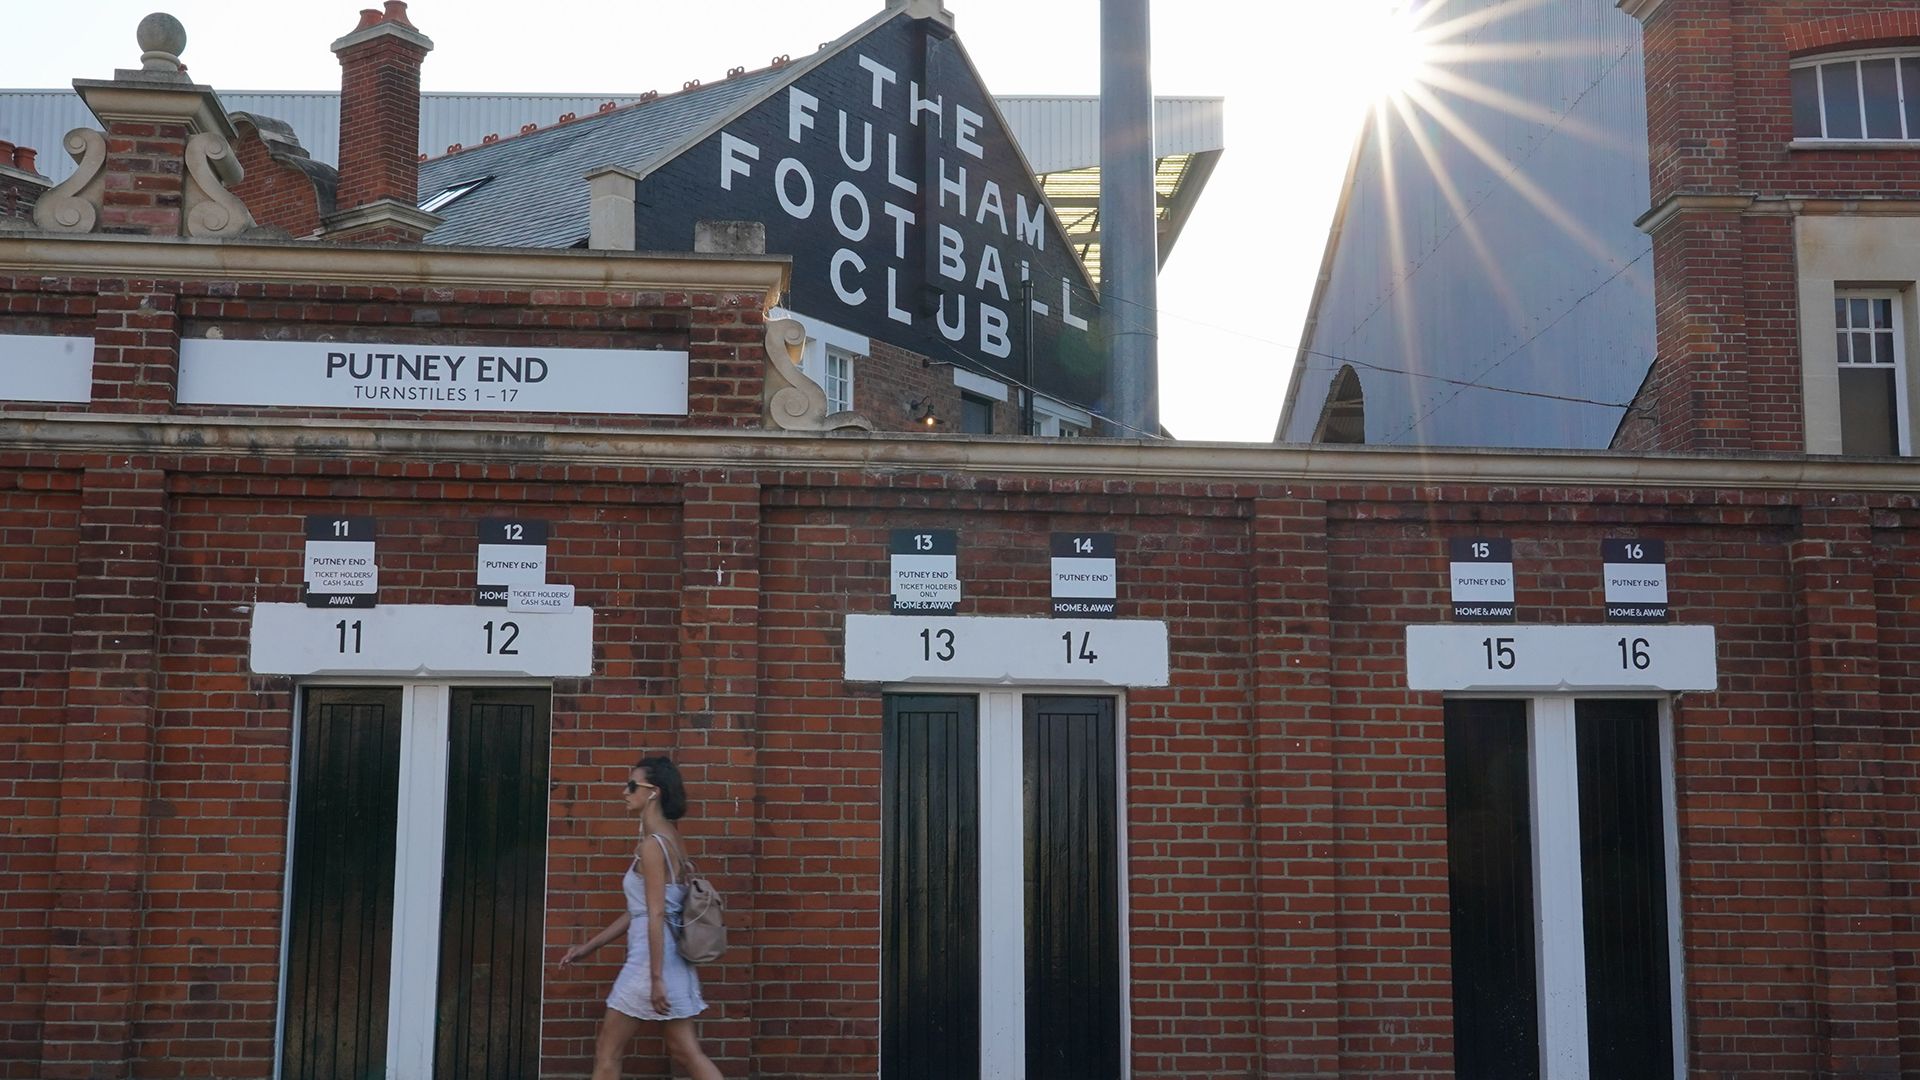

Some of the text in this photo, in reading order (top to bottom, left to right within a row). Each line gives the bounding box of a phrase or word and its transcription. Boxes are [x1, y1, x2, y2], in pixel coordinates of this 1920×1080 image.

[859, 54, 984, 160] THE
[789, 85, 1045, 252] FULHAM
[829, 248, 1012, 359] CLUB
[326, 352, 548, 383] PUTNEY END
[354, 385, 467, 401] TURNSTILES
[332, 520, 350, 537] 11
[504, 524, 523, 540] 12
[914, 534, 934, 551] 13
[1073, 537, 1094, 554] 14
[1471, 542, 1490, 558] 15
[1624, 543, 1644, 560] 16
[313, 558, 367, 566] PUTNEY END
[486, 561, 539, 570] PUTNEY END
[322, 579, 341, 587] CASH
[898, 571, 931, 579] PUTNEY
[1059, 574, 1109, 582] PUTNEY END
[1458, 578, 1489, 586] PUTNEY
[1611, 579, 1660, 587] PUTNEY END
[513, 590, 536, 598] TICKET
[900, 583, 958, 591] TICKET HOLDERS
[919, 591, 938, 599] ONLY
[328, 596, 356, 606] AWAY
[479, 591, 508, 600] HOME
[520, 598, 561, 607] CASH SALES
[335, 619, 362, 654] 11
[483, 620, 520, 655] 12
[920, 628, 955, 662] 13
[1062, 631, 1098, 664] 14
[1482, 637, 1516, 670] 15
[1617, 637, 1651, 670] 16
